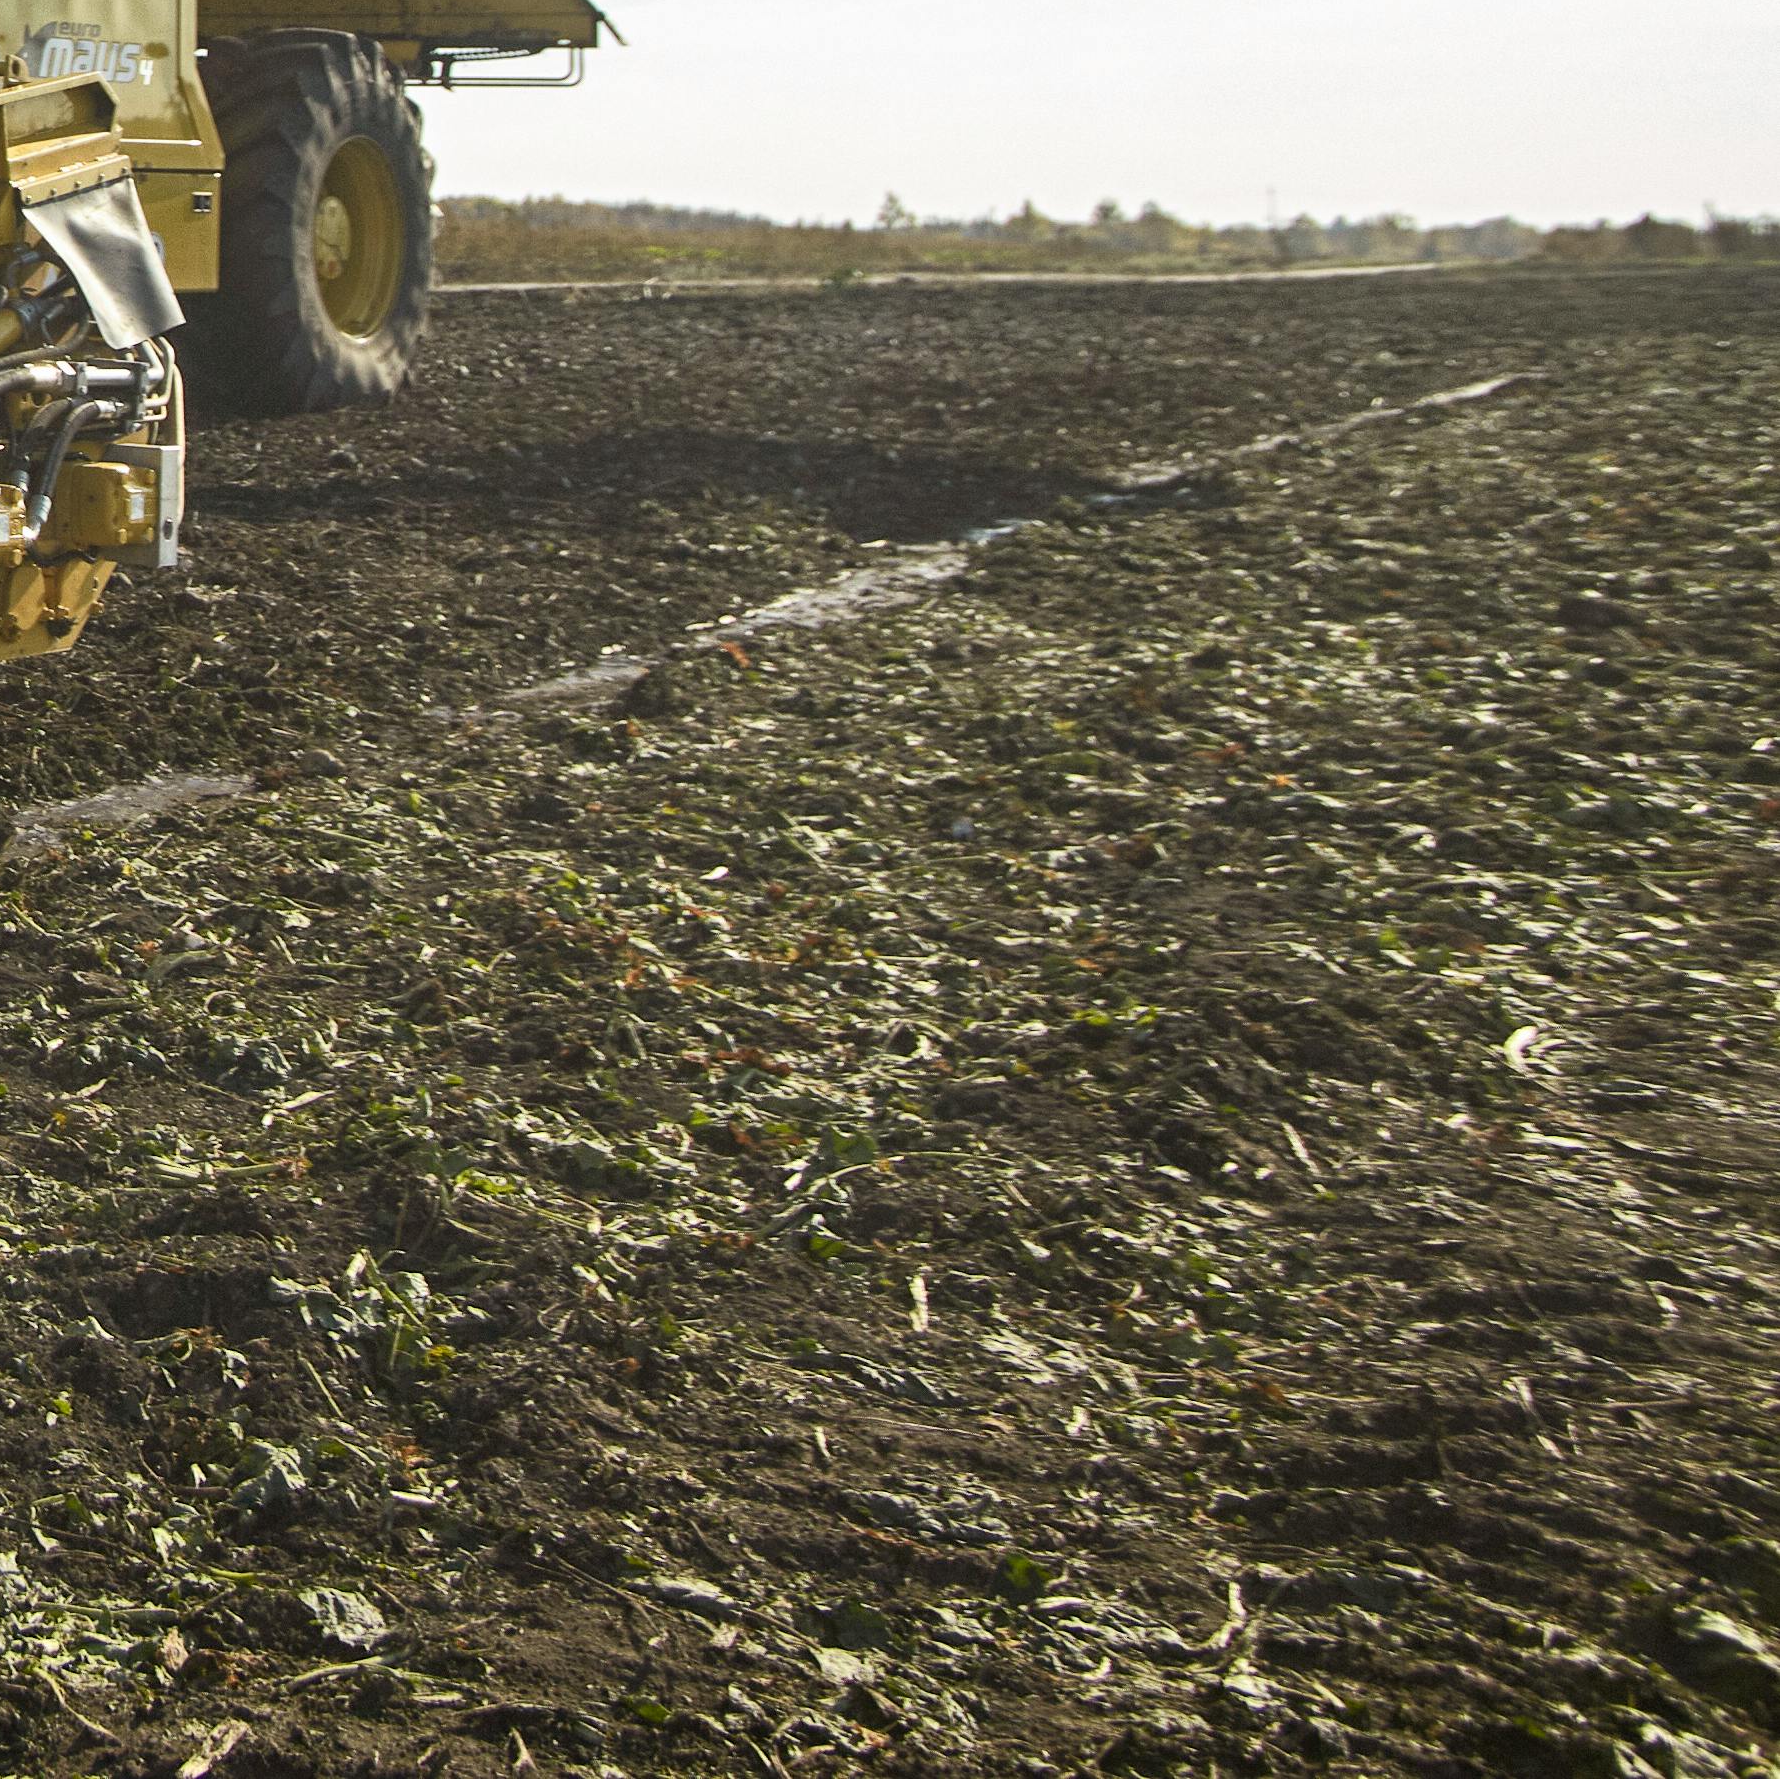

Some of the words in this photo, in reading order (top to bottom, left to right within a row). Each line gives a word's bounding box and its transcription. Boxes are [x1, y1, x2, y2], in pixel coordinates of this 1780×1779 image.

[58, 21, 102, 38] euro
[38, 36, 143, 84] maus
[138, 59, 154, 86] 4
